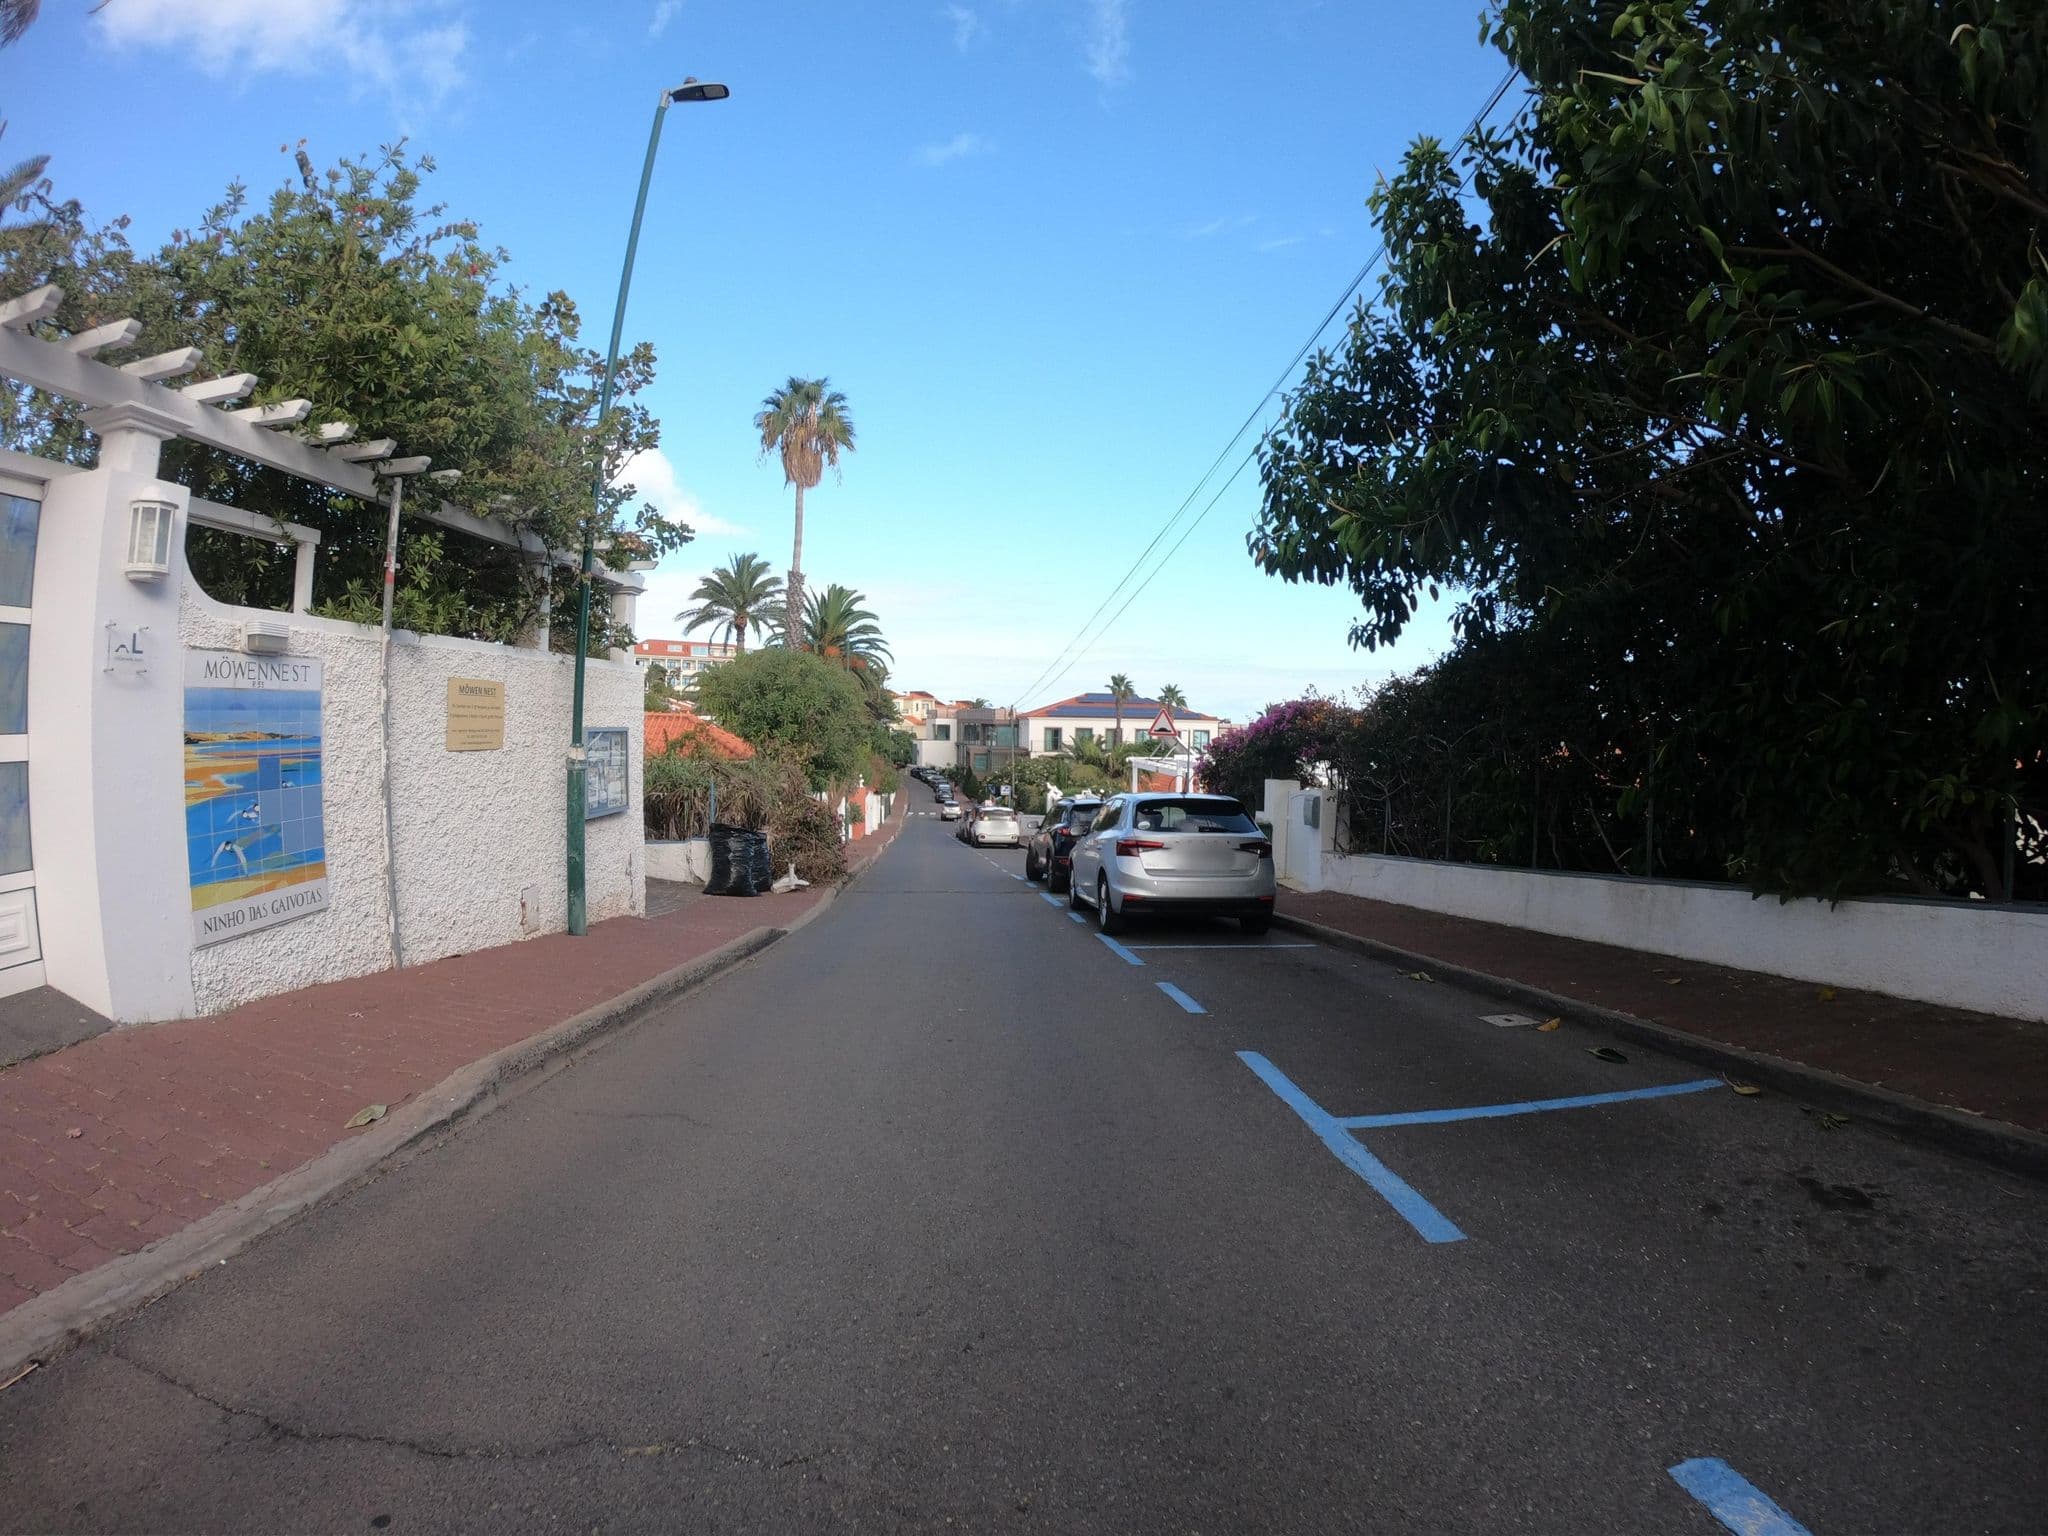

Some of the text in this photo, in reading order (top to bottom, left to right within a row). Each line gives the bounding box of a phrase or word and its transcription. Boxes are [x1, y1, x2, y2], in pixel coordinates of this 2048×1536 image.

[204, 656, 311, 682] MÖWENNEST
[459, 683, 496, 696] MÖWEN NEST
[203, 887, 323, 935] NINHO DAS GAIVOTAS
